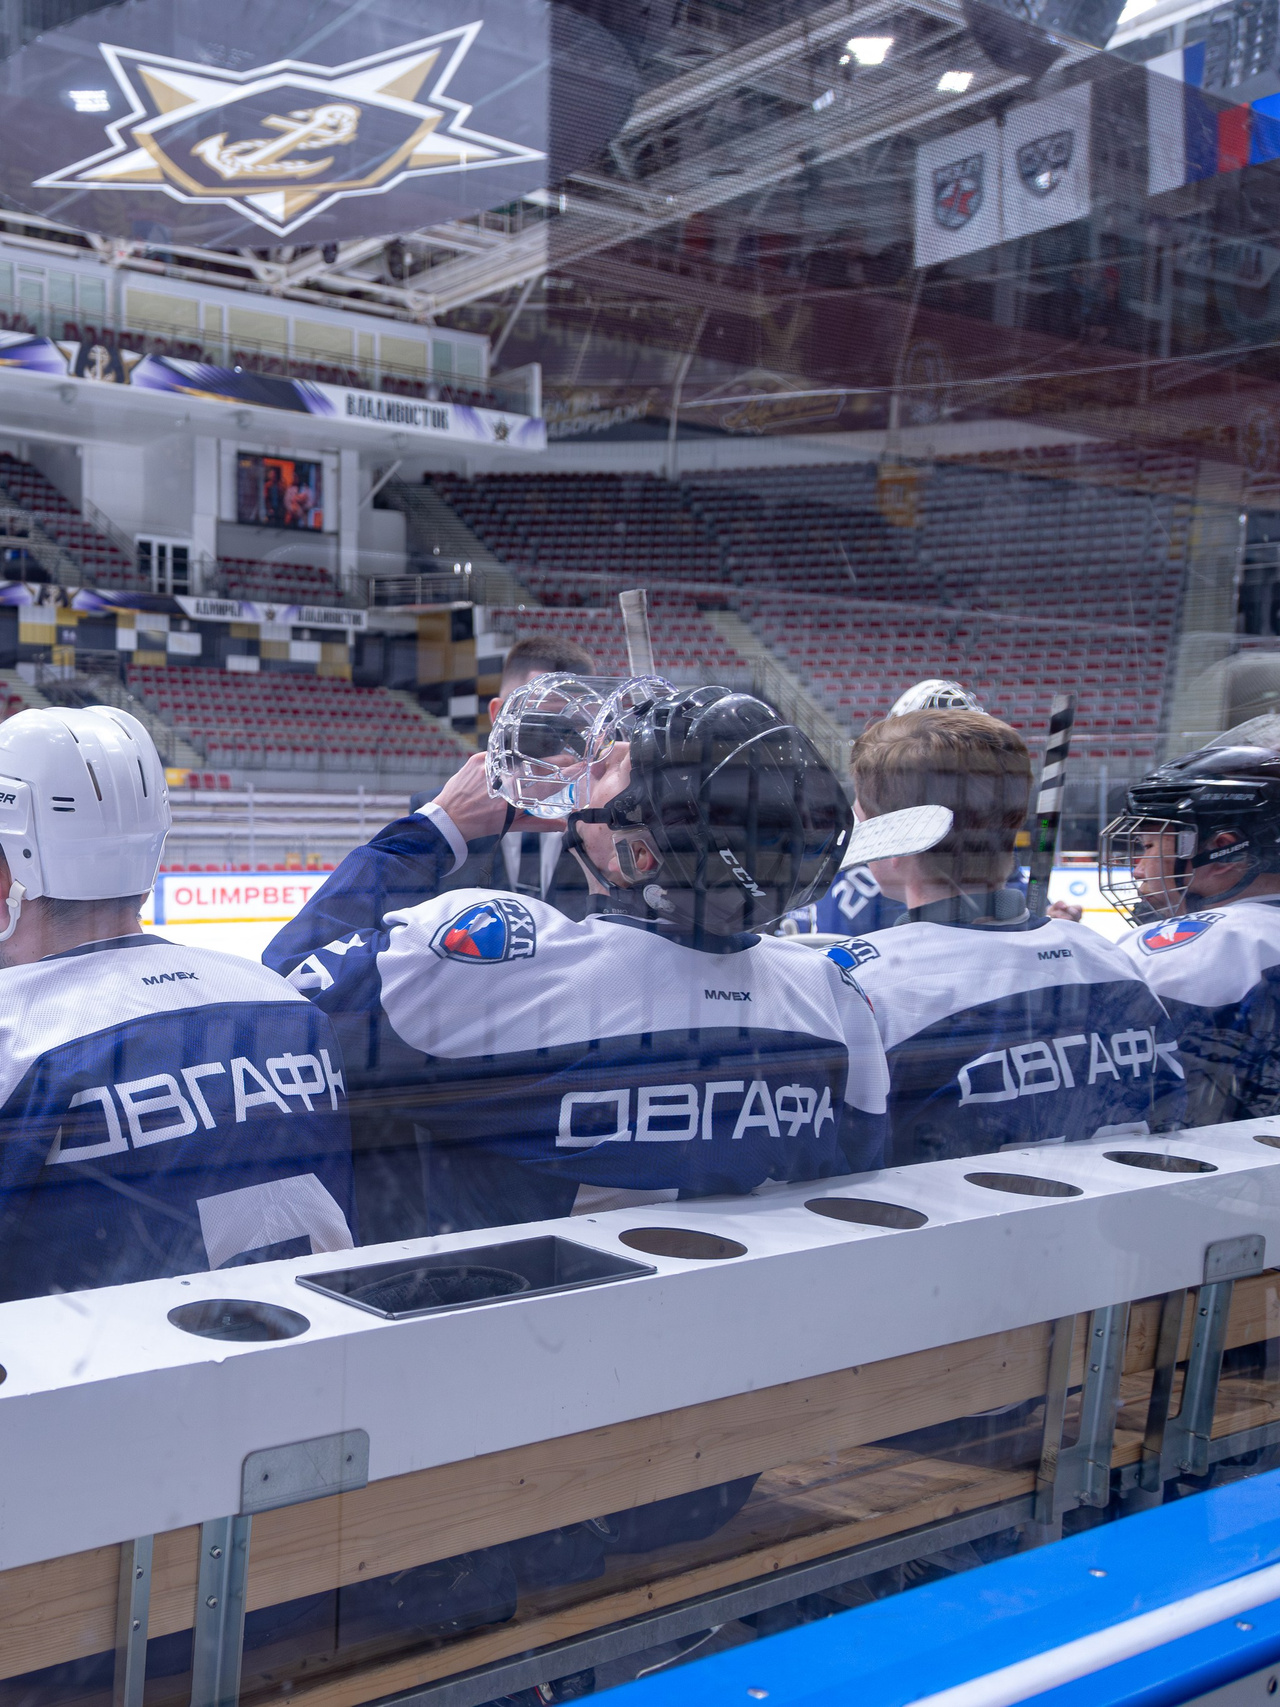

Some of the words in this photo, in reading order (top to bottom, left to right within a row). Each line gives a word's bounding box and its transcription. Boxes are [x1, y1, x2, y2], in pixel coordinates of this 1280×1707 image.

[345, 392, 450, 430] ВЛАДИВОСТОК
[1209, 840, 1251, 860] BAUER
[719, 848, 767, 897] CCM
[175, 886, 312, 905] OLIMPBET
[832, 866, 881, 920] 20
[142, 971, 199, 985] MAVEX
[705, 989, 752, 1001] MAVEX
